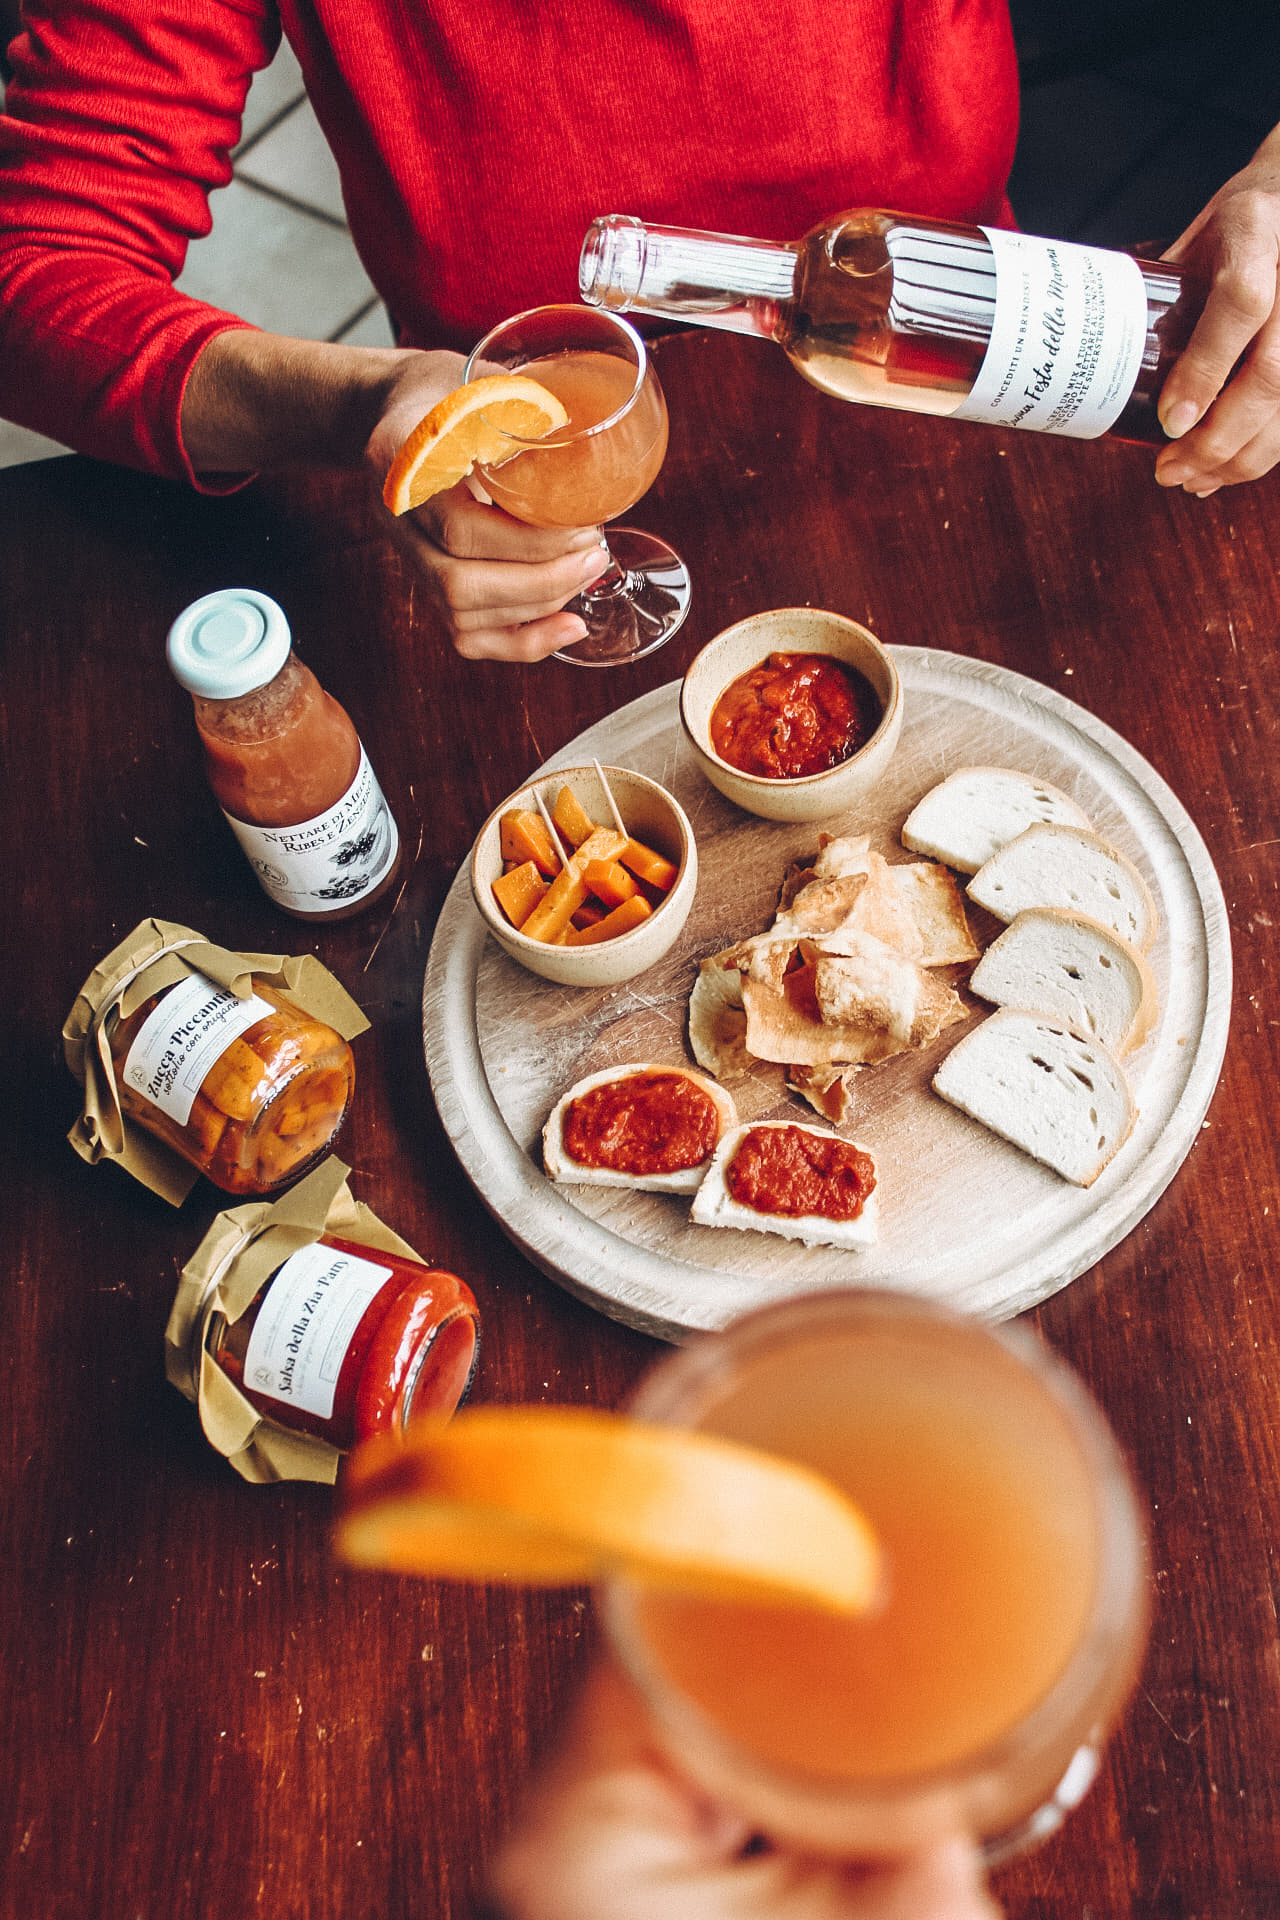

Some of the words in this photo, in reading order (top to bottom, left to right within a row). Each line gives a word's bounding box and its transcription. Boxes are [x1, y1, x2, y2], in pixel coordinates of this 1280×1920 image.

[1047, 248, 1068, 301] Mamma
[1042, 305, 1066, 356] della
[1078, 338, 1087, 359] TUO
[991, 357, 1019, 408] CONCEDITI
[1015, 338, 1025, 354] UN
[1075, 361, 1082, 369] A
[1080, 331, 1096, 379] NETTARE
[1024, 361, 1054, 401] Festa
[1060, 391, 1071, 404] UN
[1067, 371, 1079, 391] MIX
[1080, 384, 1089, 395] TE
[1068, 404, 1079, 418] CIN
[1077, 396, 1084, 404] A
[185, 1034, 202, 1052] con
[202, 1000, 240, 1031] origano
[148, 1049, 175, 1099] Zucca
[170, 990, 236, 1045] Piccantin
[303, 1290, 324, 1315] Zia
[286, 1318, 310, 1354] della
[278, 1357, 296, 1395] Salsa
